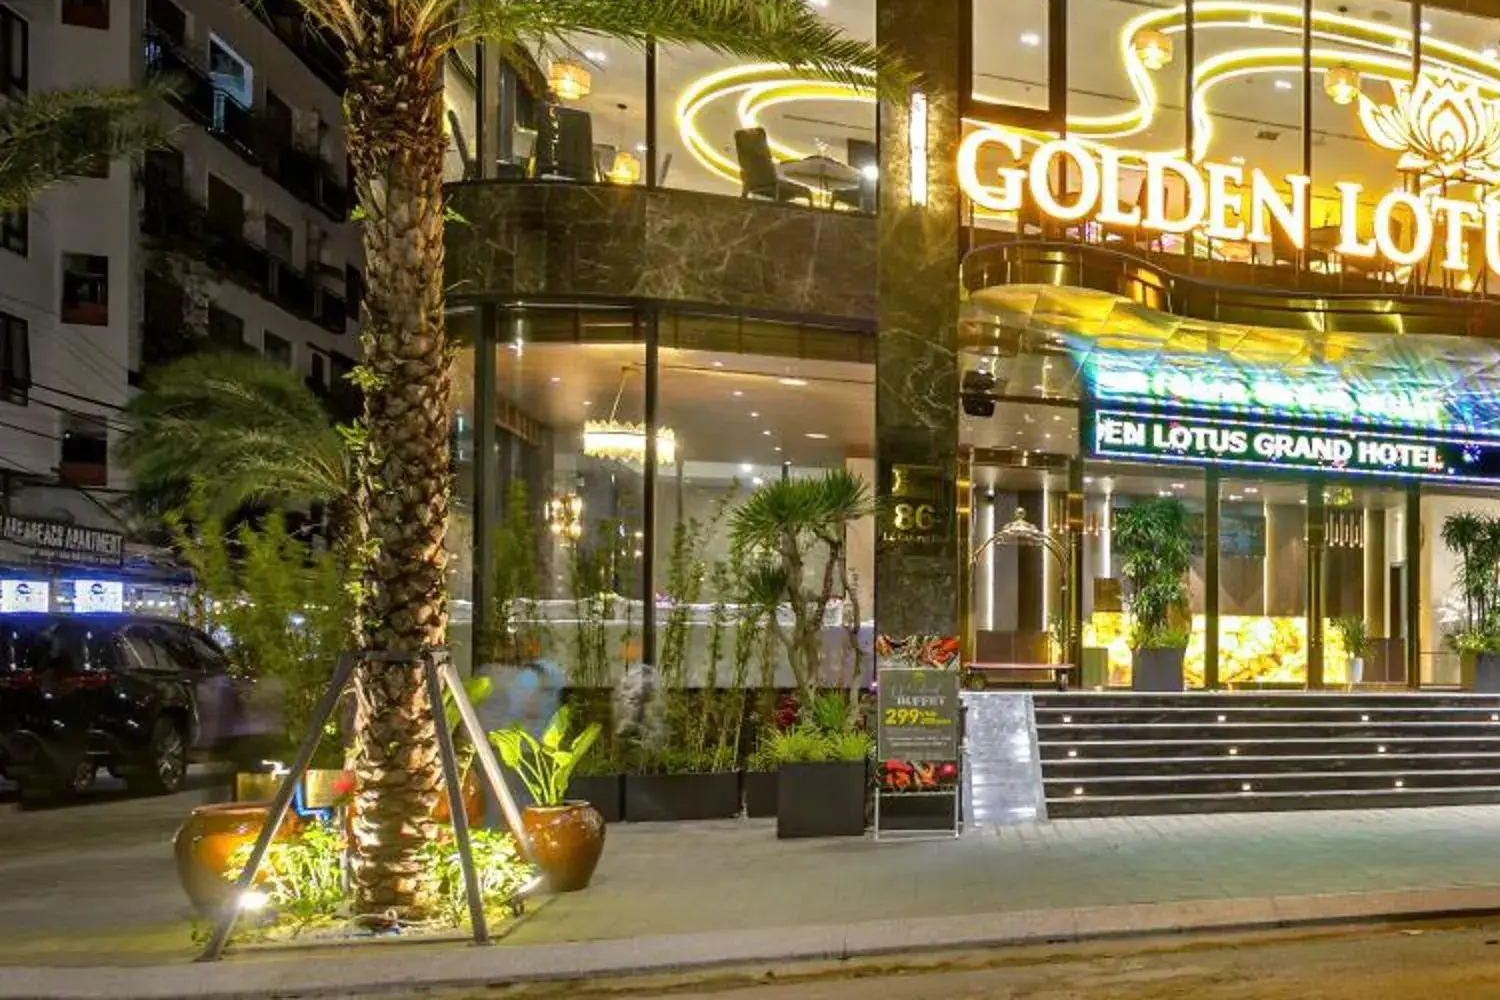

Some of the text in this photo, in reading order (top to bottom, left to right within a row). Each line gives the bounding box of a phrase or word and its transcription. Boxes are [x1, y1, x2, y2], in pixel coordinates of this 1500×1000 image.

[957, 129, 1310, 249] GOLDEN
[1153, 423, 1248, 454] LOTUS
[1253, 432, 1352, 464] GRAND
[1358, 441, 1442, 470] HOTEL
[894, 503, 936, 531] 86
[885, 707, 919, 725] 299
